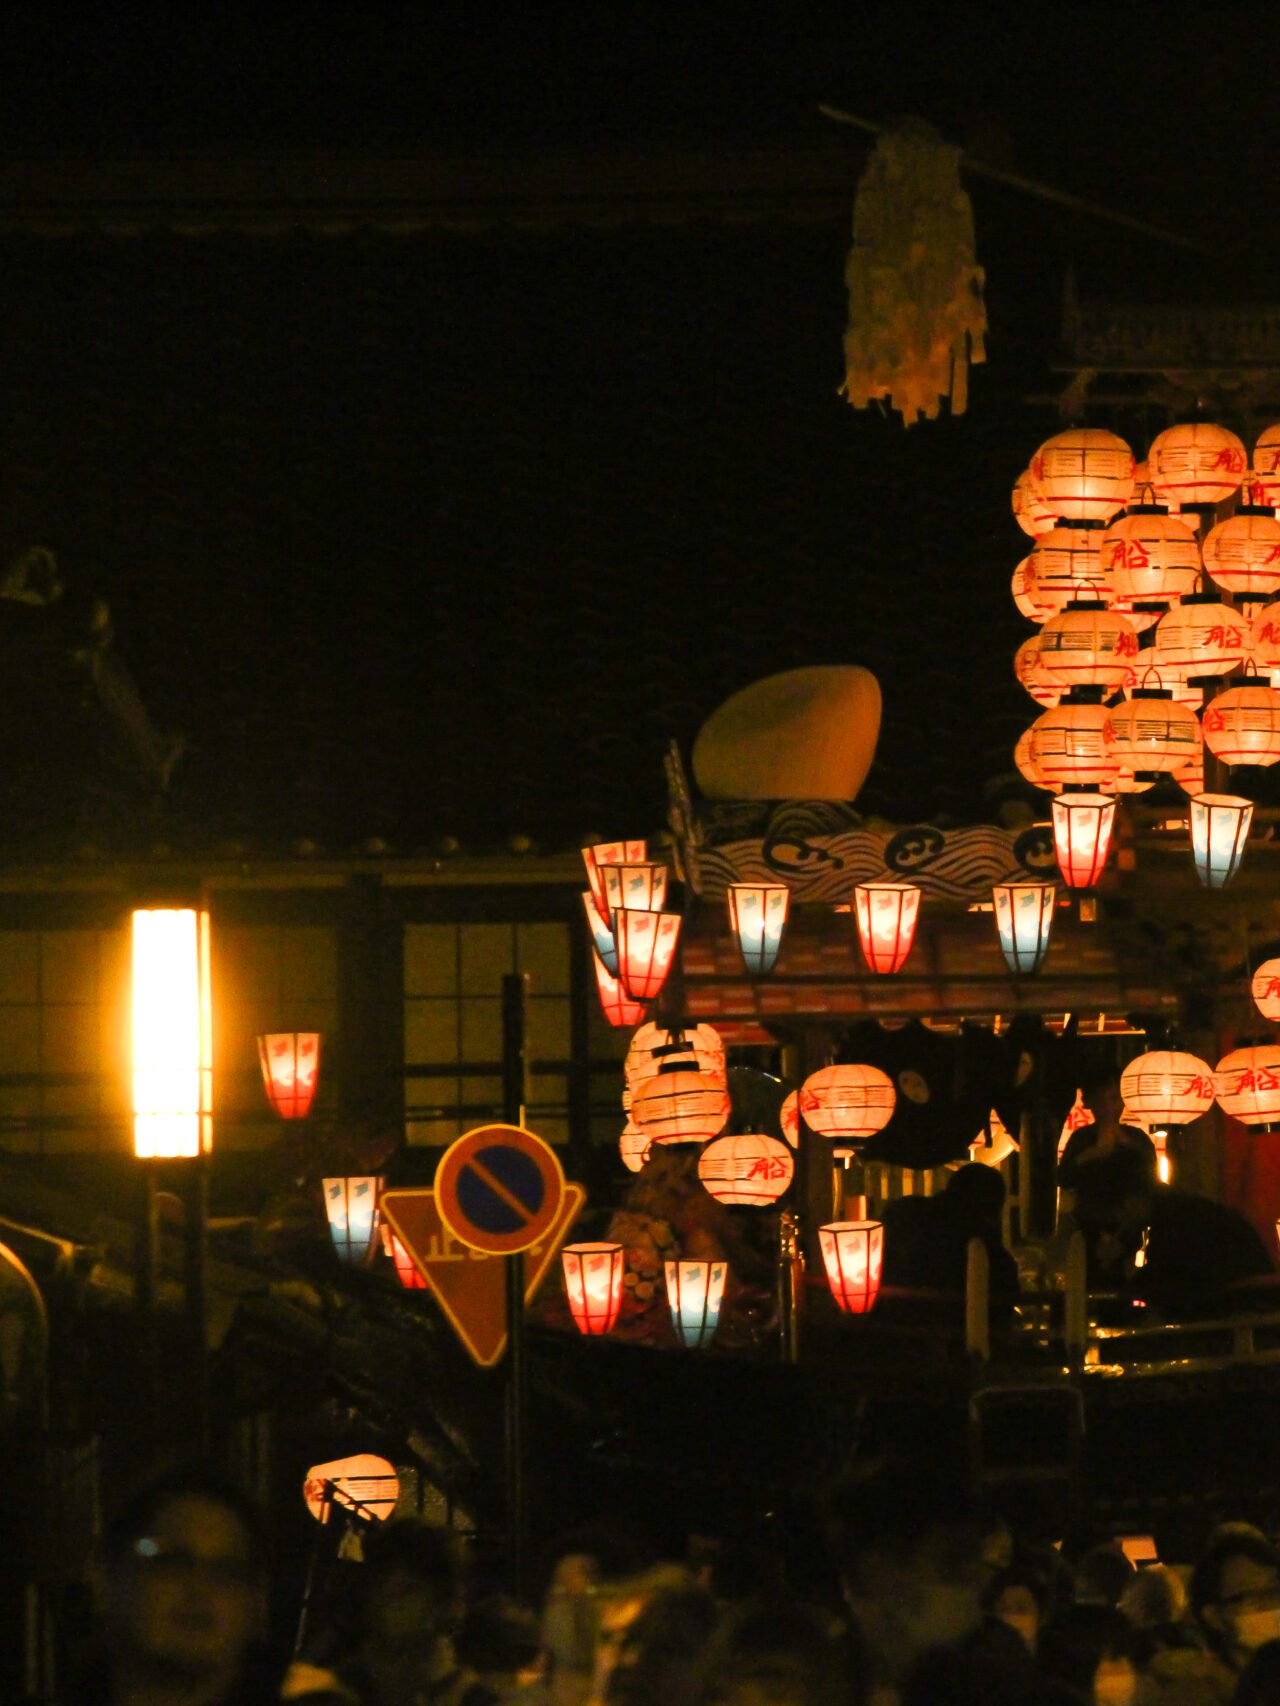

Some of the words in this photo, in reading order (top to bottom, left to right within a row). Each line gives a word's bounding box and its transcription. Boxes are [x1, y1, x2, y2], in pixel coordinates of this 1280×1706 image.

[1111, 540, 1151, 569] 船
[1202, 625, 1243, 648] 船
[1184, 1075, 1215, 1098] 船
[1236, 1068, 1280, 1092] 船
[748, 1158, 788, 1180] 船
